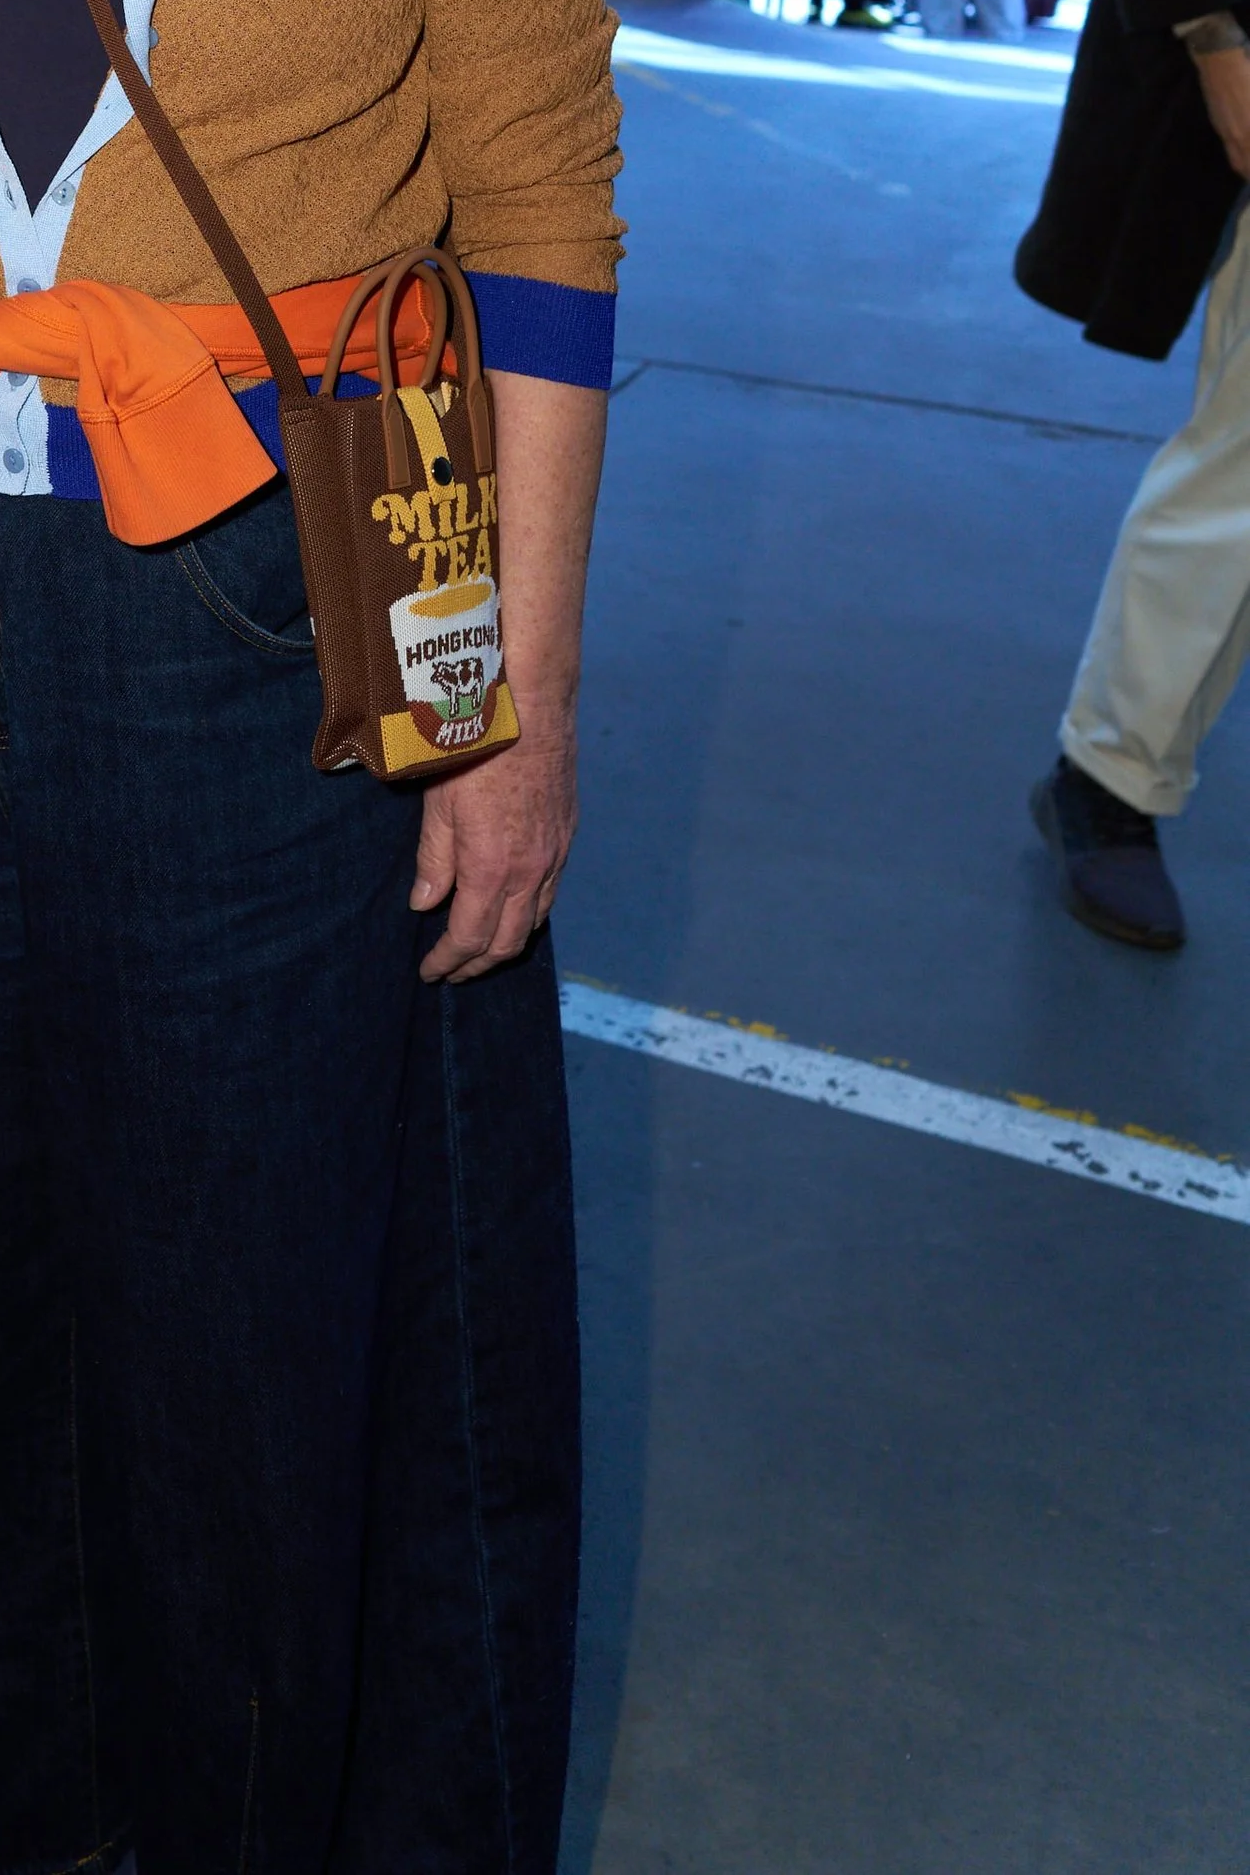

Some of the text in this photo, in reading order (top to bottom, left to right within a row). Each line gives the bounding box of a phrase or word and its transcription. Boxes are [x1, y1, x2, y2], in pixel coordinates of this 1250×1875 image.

[371, 473, 497, 545] MILK
[408, 528, 492, 592] TEA
[435, 713, 485, 747] MILK
